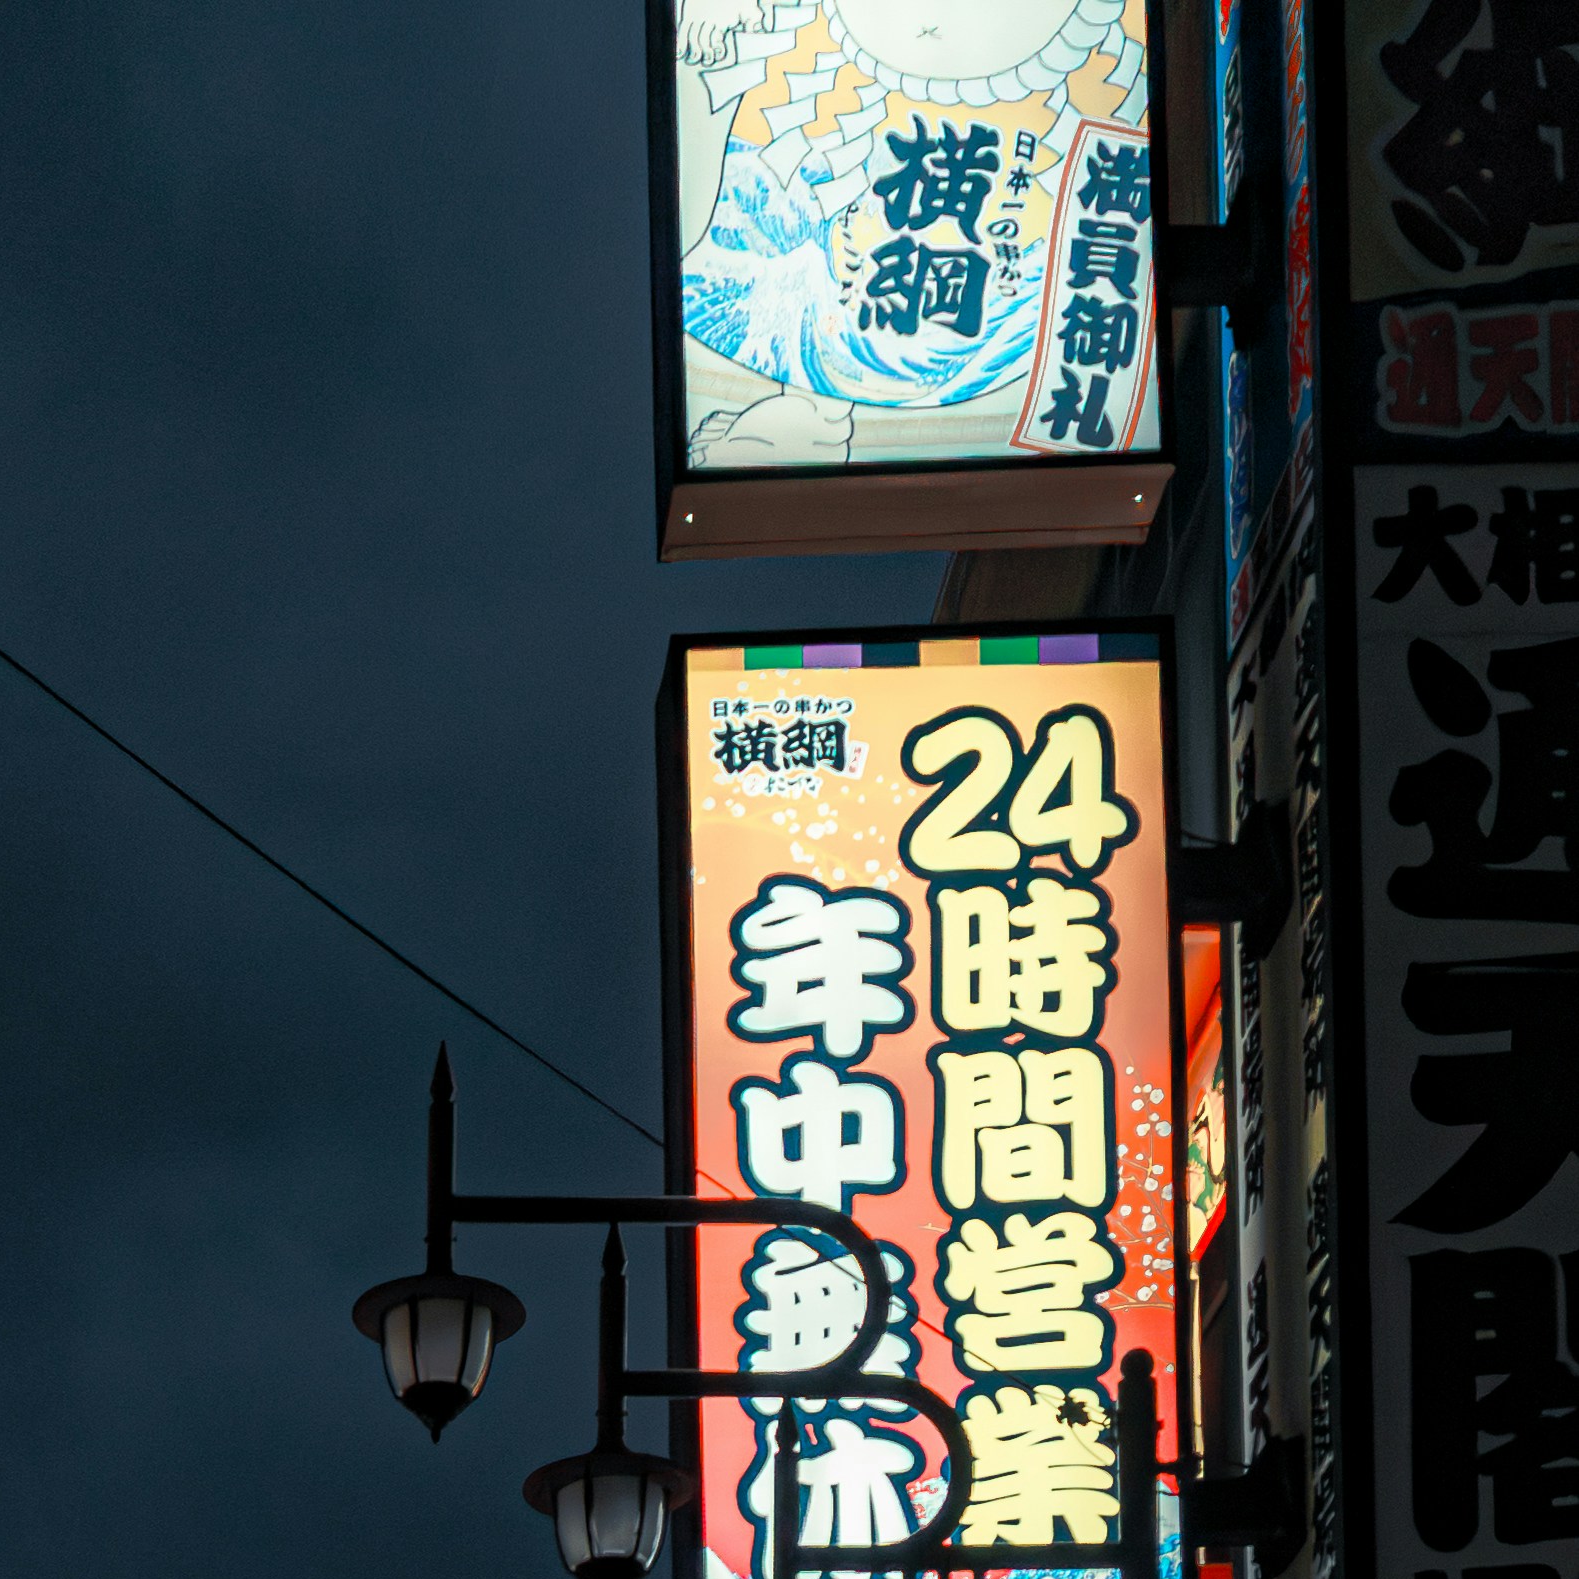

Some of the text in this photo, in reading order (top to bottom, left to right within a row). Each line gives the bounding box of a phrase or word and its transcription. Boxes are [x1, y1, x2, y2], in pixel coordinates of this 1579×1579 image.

[872, 113, 1002, 338] 横綱
[1041, 140, 1152, 448] 満員御礼
[713, 700, 852, 717] 日本一の串かつ
[714, 718, 847, 774] 横綱
[902, 708, 1136, 1546] 24時間営業
